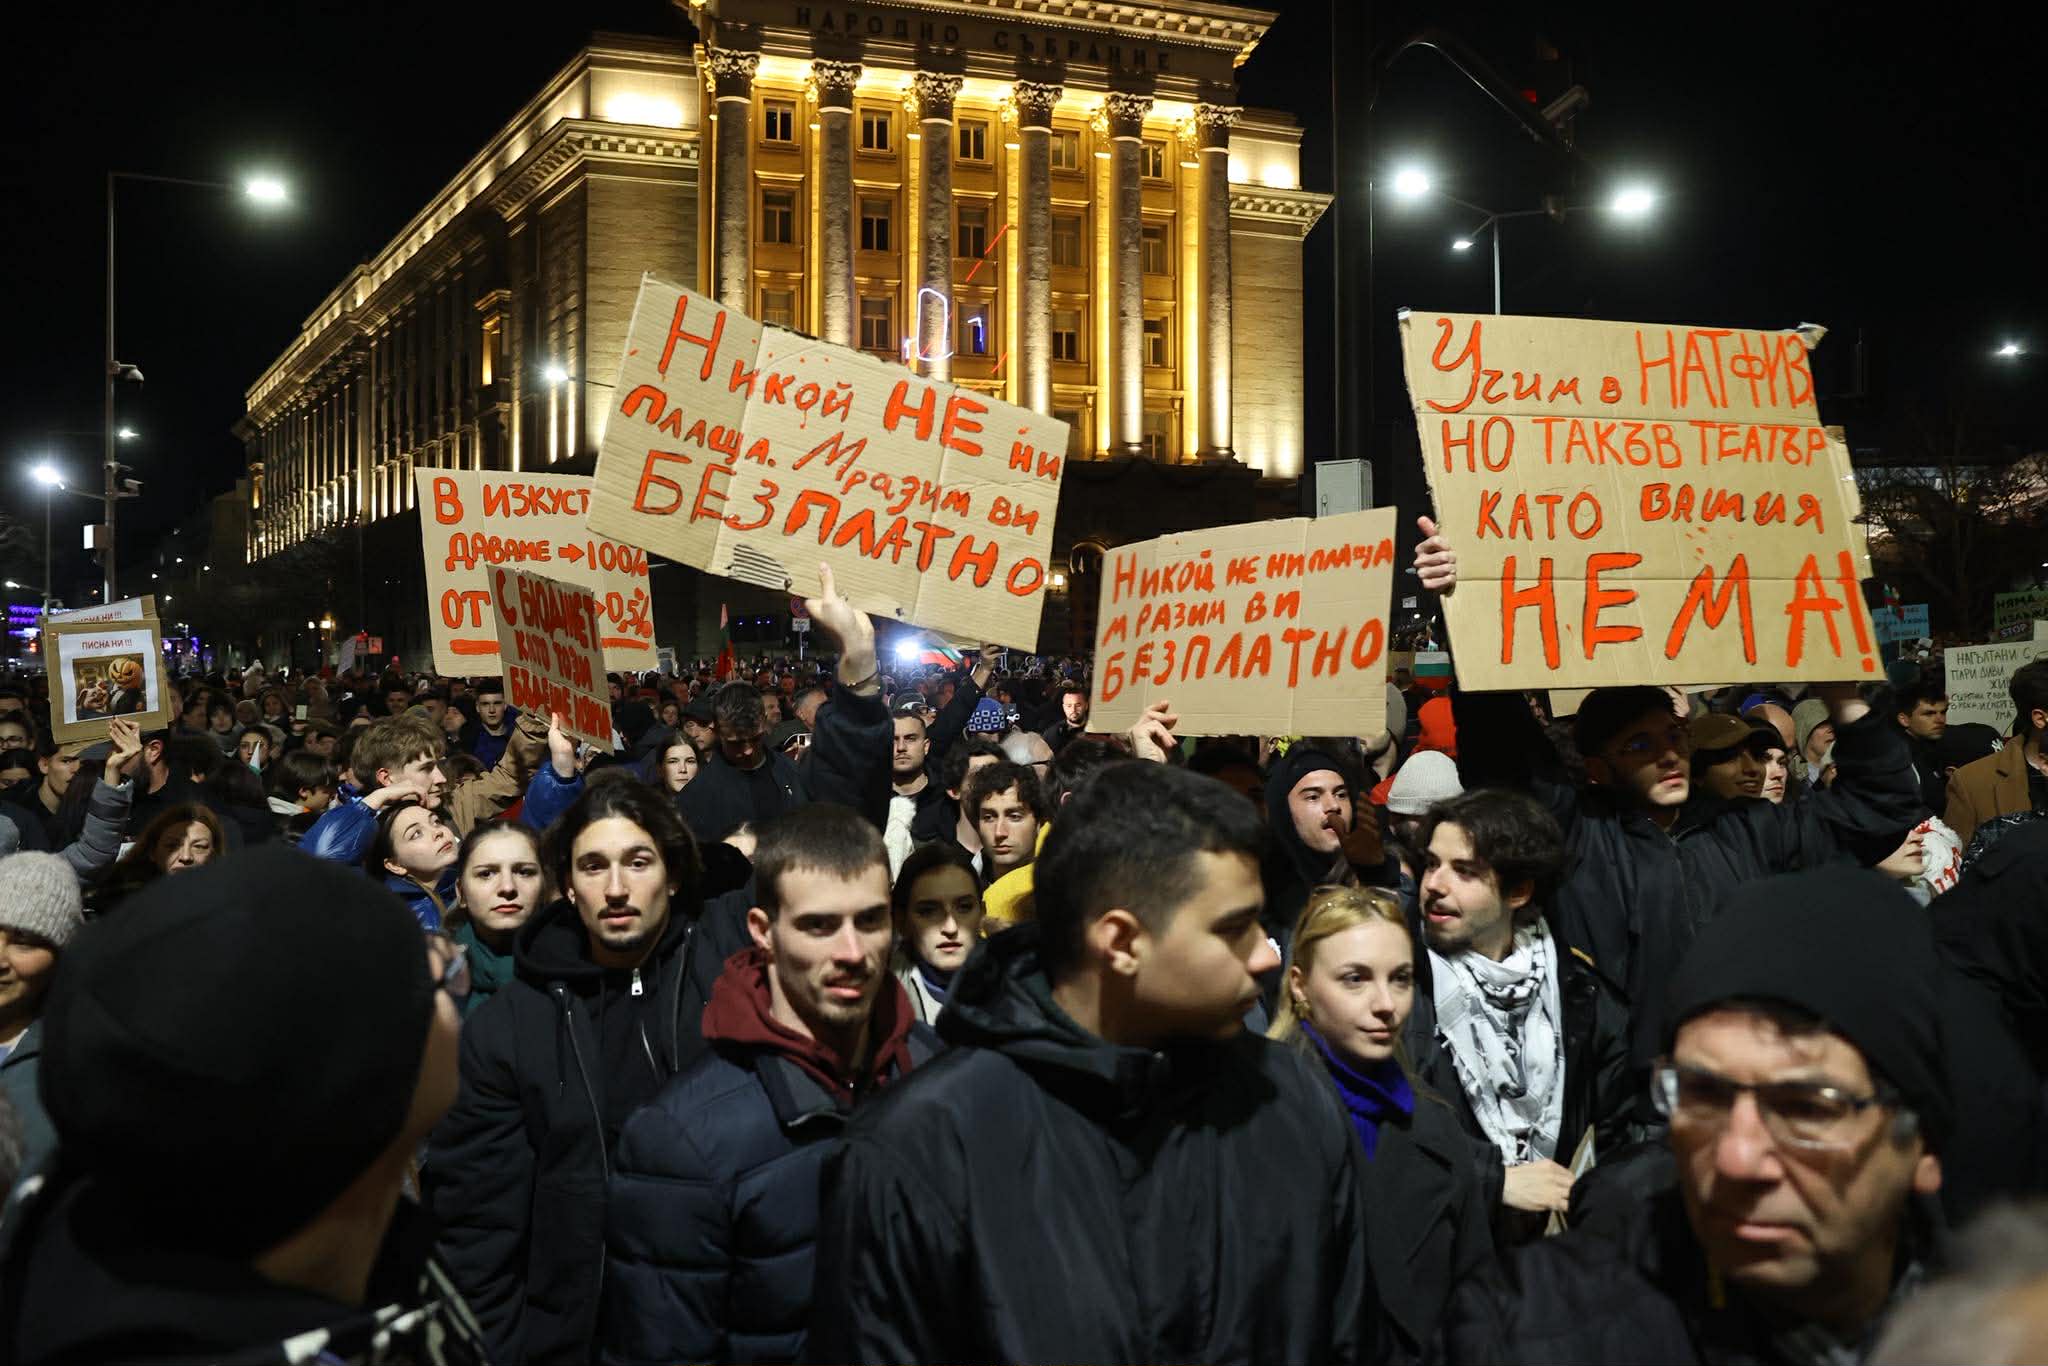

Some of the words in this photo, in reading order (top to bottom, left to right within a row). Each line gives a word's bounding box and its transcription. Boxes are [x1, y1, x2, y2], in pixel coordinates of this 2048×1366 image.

[797, 7, 960, 43] НАРОДНО
[993, 31, 1169, 70] СЪБРАНИЕ
[883, 379, 988, 457] НЕ
[1442, 415, 1514, 473] НО
[1532, 416, 1683, 470] ТАКЪВ
[1689, 419, 1827, 466] ТЕАТЪР
[432, 476, 464, 525] В
[482, 483, 591, 518] ИЗКУСТ
[633, 449, 1044, 597] БЕЗПЛАТНО
[1477, 489, 1603, 540] КАТО
[1640, 481, 1825, 535] ВАШИЯ
[444, 532, 552, 572] ДАВАМЕ
[587, 541, 649, 577] 100%
[1226, 555, 1261, 586] НЕ
[440, 588, 492, 629] ОТ
[495, 569, 518, 627] С
[516, 575, 600, 653] БЮДЖЕТ
[1102, 600, 1225, 646] МРАЗИМ
[1244, 590, 1301, 624] ВИ
[1501, 550, 1875, 673] НЕМА!
[81, 640, 111, 650] ПИСНА
[111, 639, 124, 648] НИ
[514, 630, 551, 673] КАТО
[552, 641, 594, 692] ТОЗИ
[1101, 617, 1385, 702] БЕЗПЛАТНО
[1956, 648, 2017, 665] НАГЪЛТАНИ
[1951, 668, 1978, 681] ПАРИ
